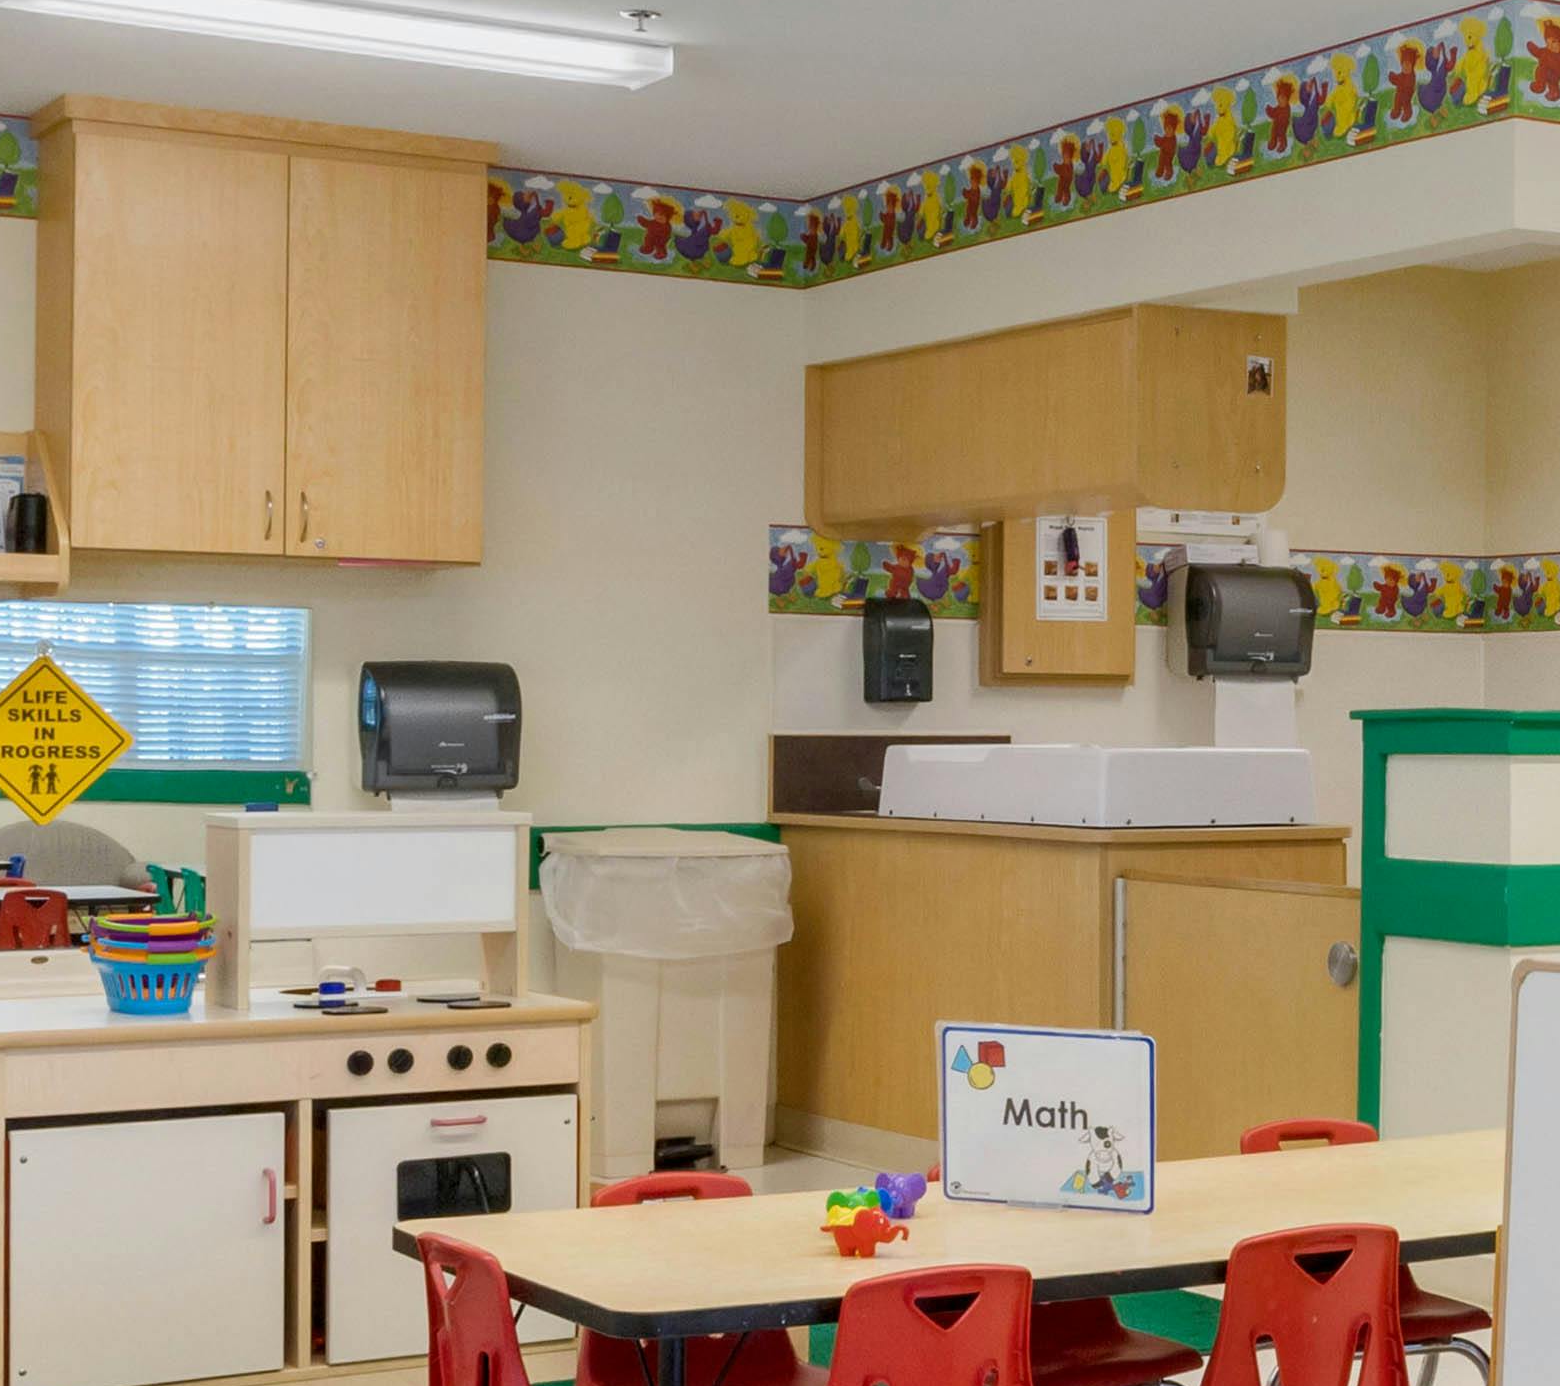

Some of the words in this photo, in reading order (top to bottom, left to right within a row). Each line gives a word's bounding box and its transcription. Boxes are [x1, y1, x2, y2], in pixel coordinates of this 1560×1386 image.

[22, 690, 67, 704] LIFE
[7, 708, 82, 723] SKILLS
[34, 727, 56, 741] IN
[1002, 1097, 1089, 1130] Math
